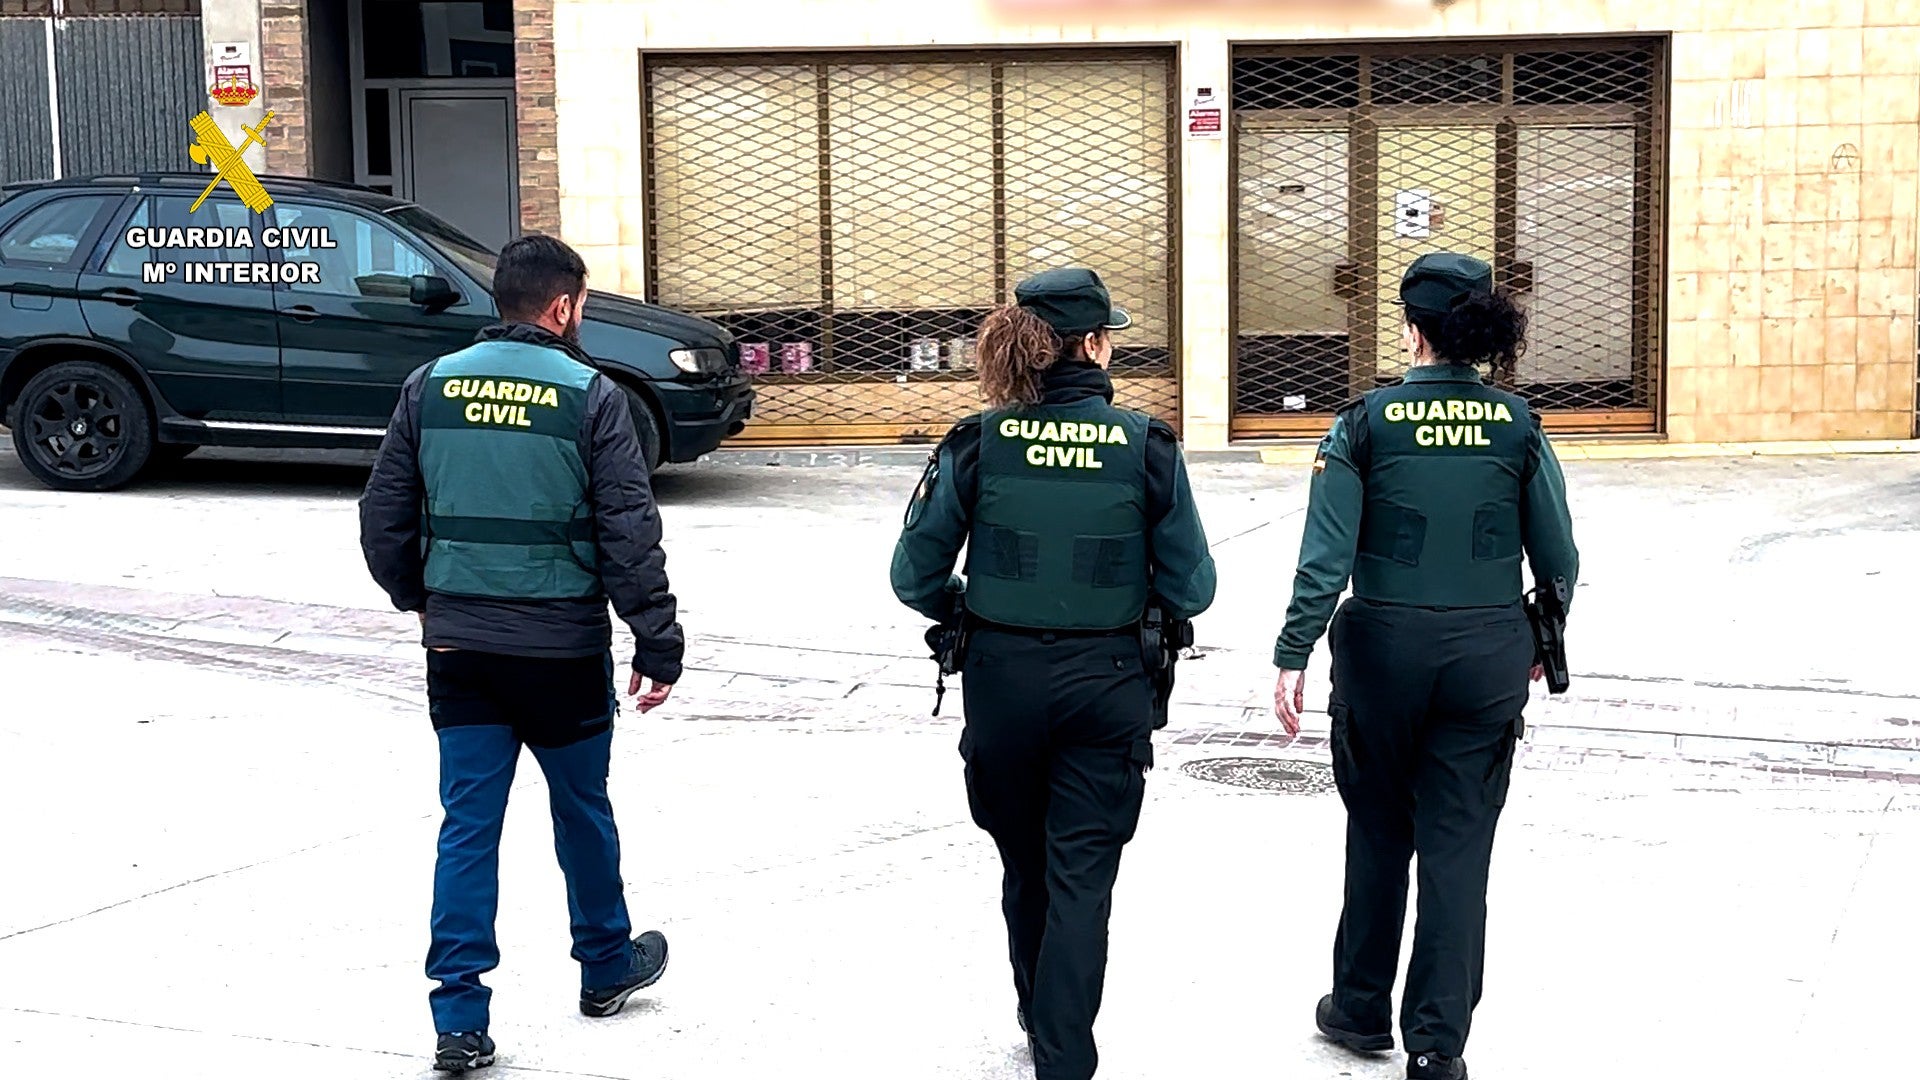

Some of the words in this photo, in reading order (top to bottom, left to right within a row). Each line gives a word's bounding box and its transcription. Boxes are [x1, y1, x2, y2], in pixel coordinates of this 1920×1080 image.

[443, 379, 558, 407] GUARDIA
[465, 402, 532, 427] CIVIL
[1384, 400, 1513, 422] GUARDIA
[999, 418, 1128, 445] GUARDIA
[1415, 425, 1491, 446] CIVIL
[1026, 444, 1103, 468] CIVIL
